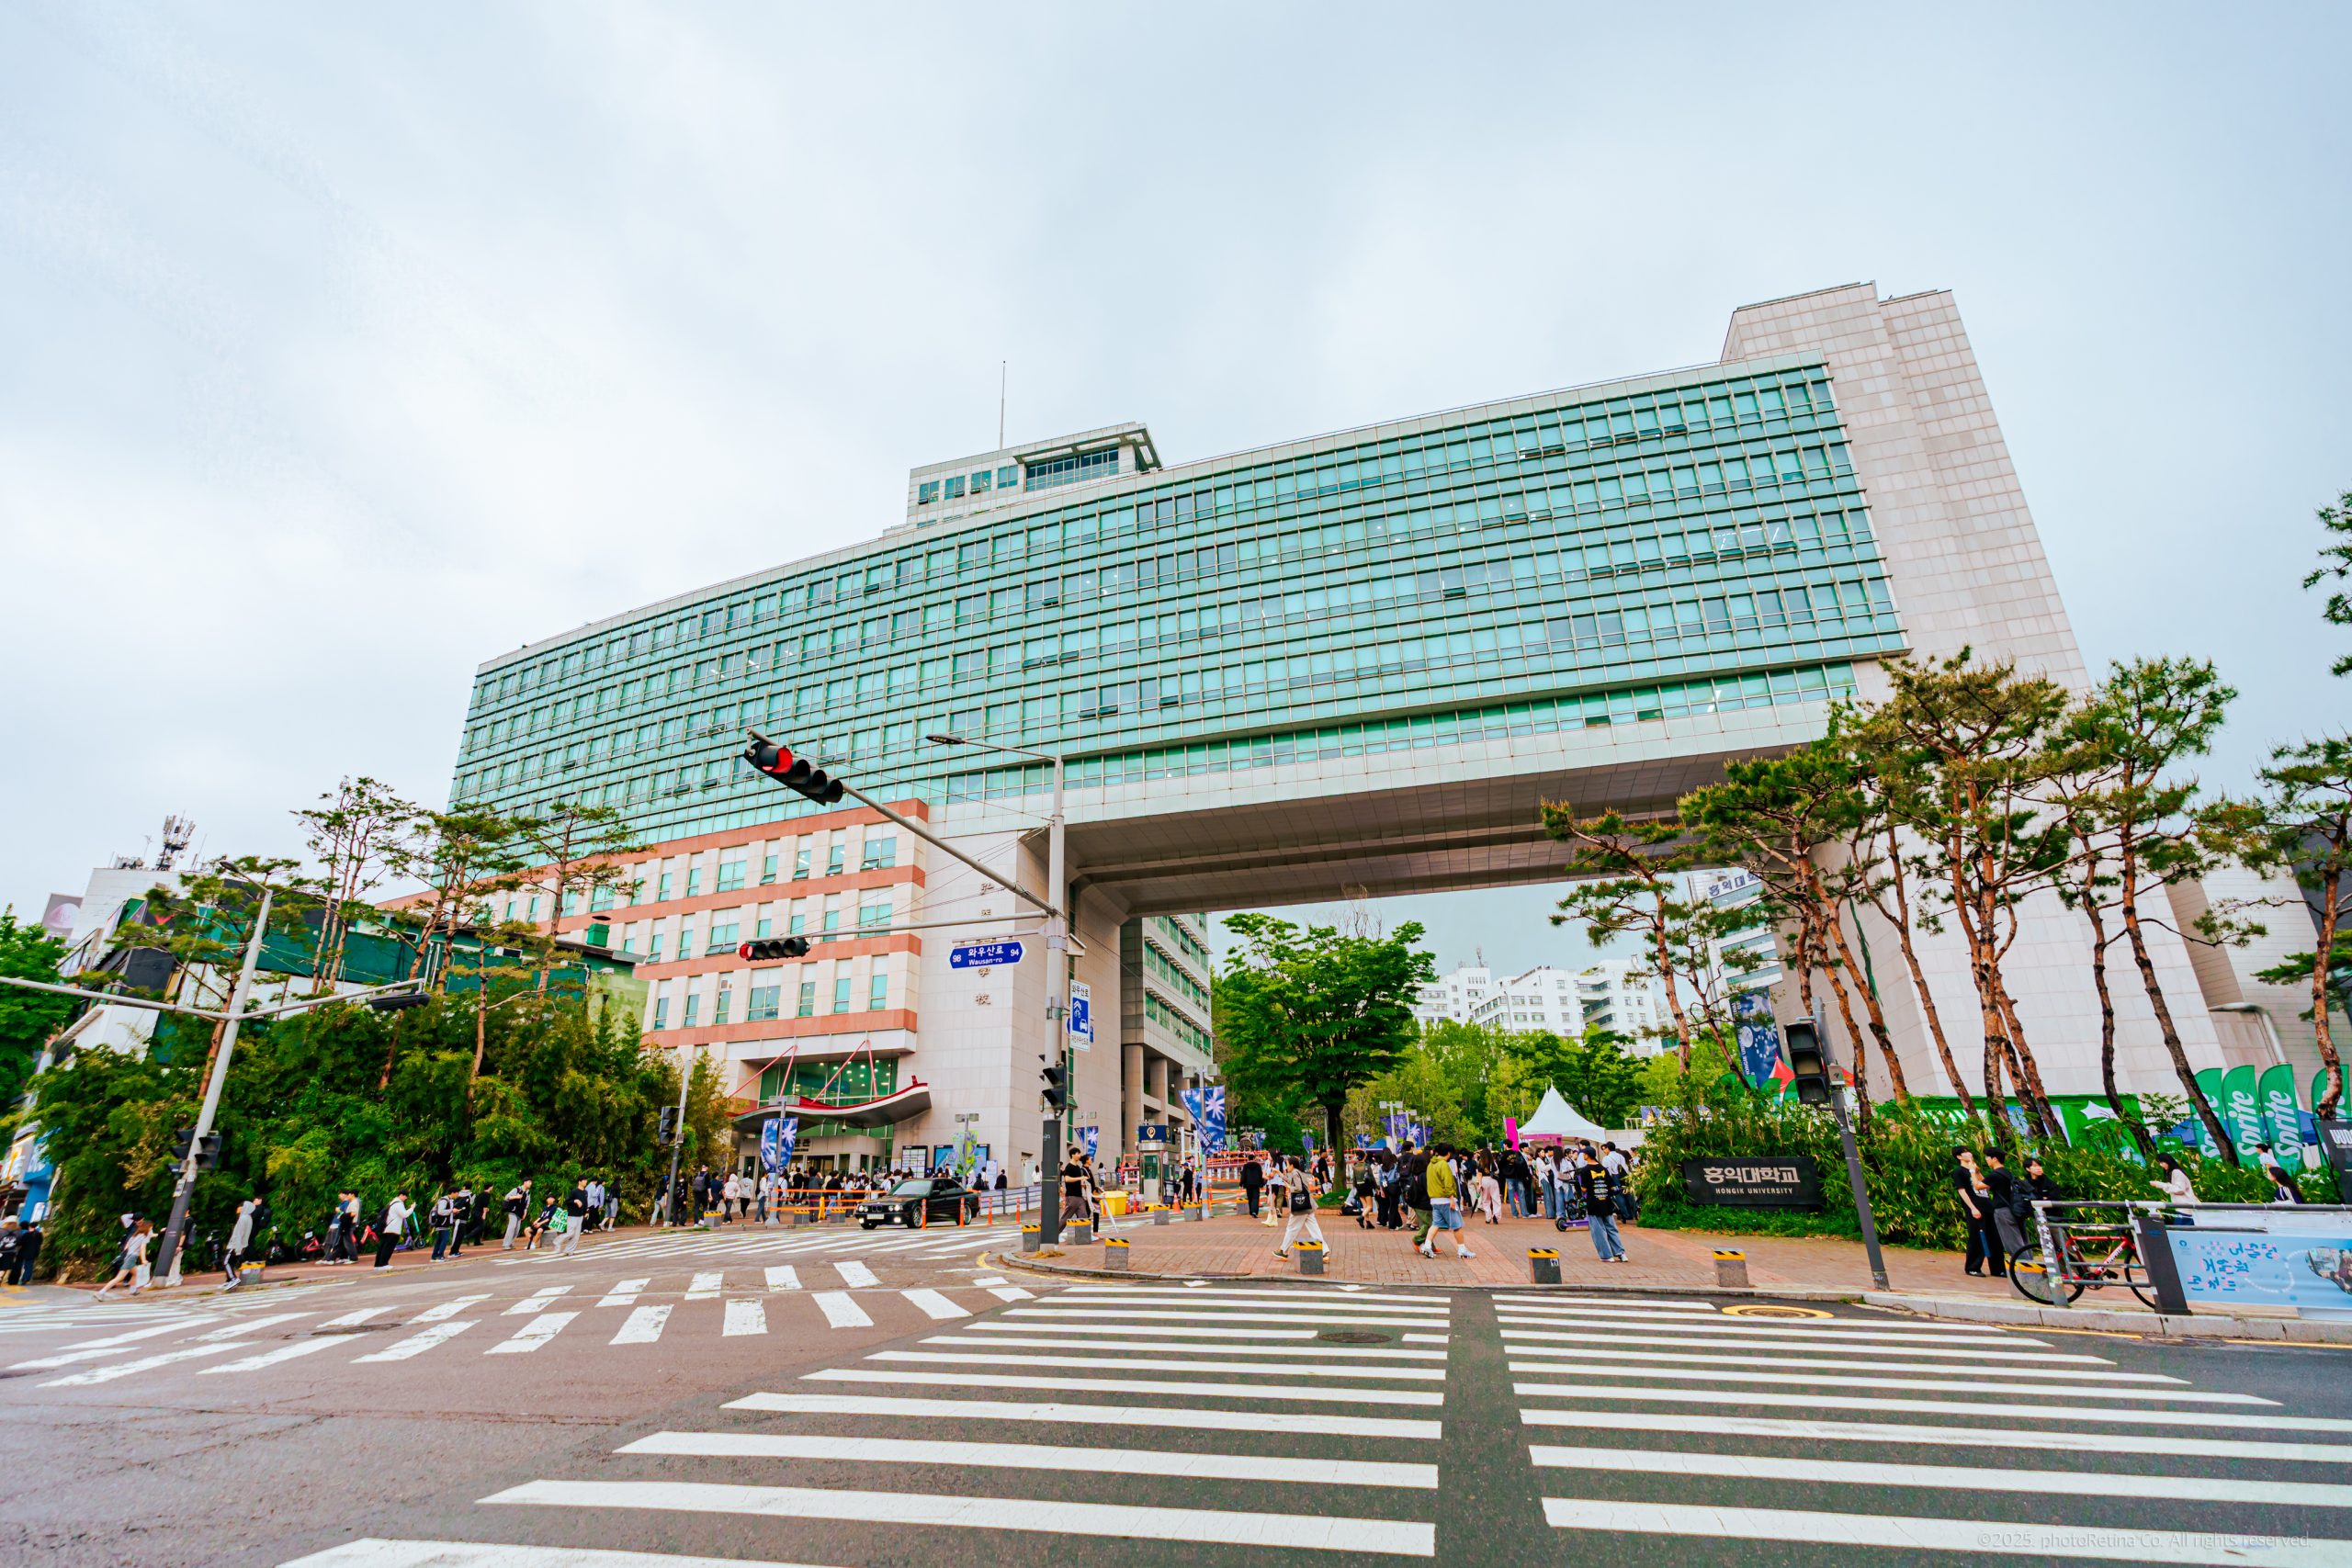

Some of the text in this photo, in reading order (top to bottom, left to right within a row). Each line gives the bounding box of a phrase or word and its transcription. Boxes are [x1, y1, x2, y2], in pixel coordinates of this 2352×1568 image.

[952, 945, 1020, 963] 98 와우산로 94
[968, 957, 1003, 965] Wausan-ro
[1071, 984, 1089, 998] 와우산로
[2228, 1090, 2264, 1156] Sprite
[2265, 1089, 2301, 1161] Sprite
[1702, 1166, 1801, 1184] 홍익대학교
[1715, 1187, 1793, 1195] HONGIK UNIVERSITY
